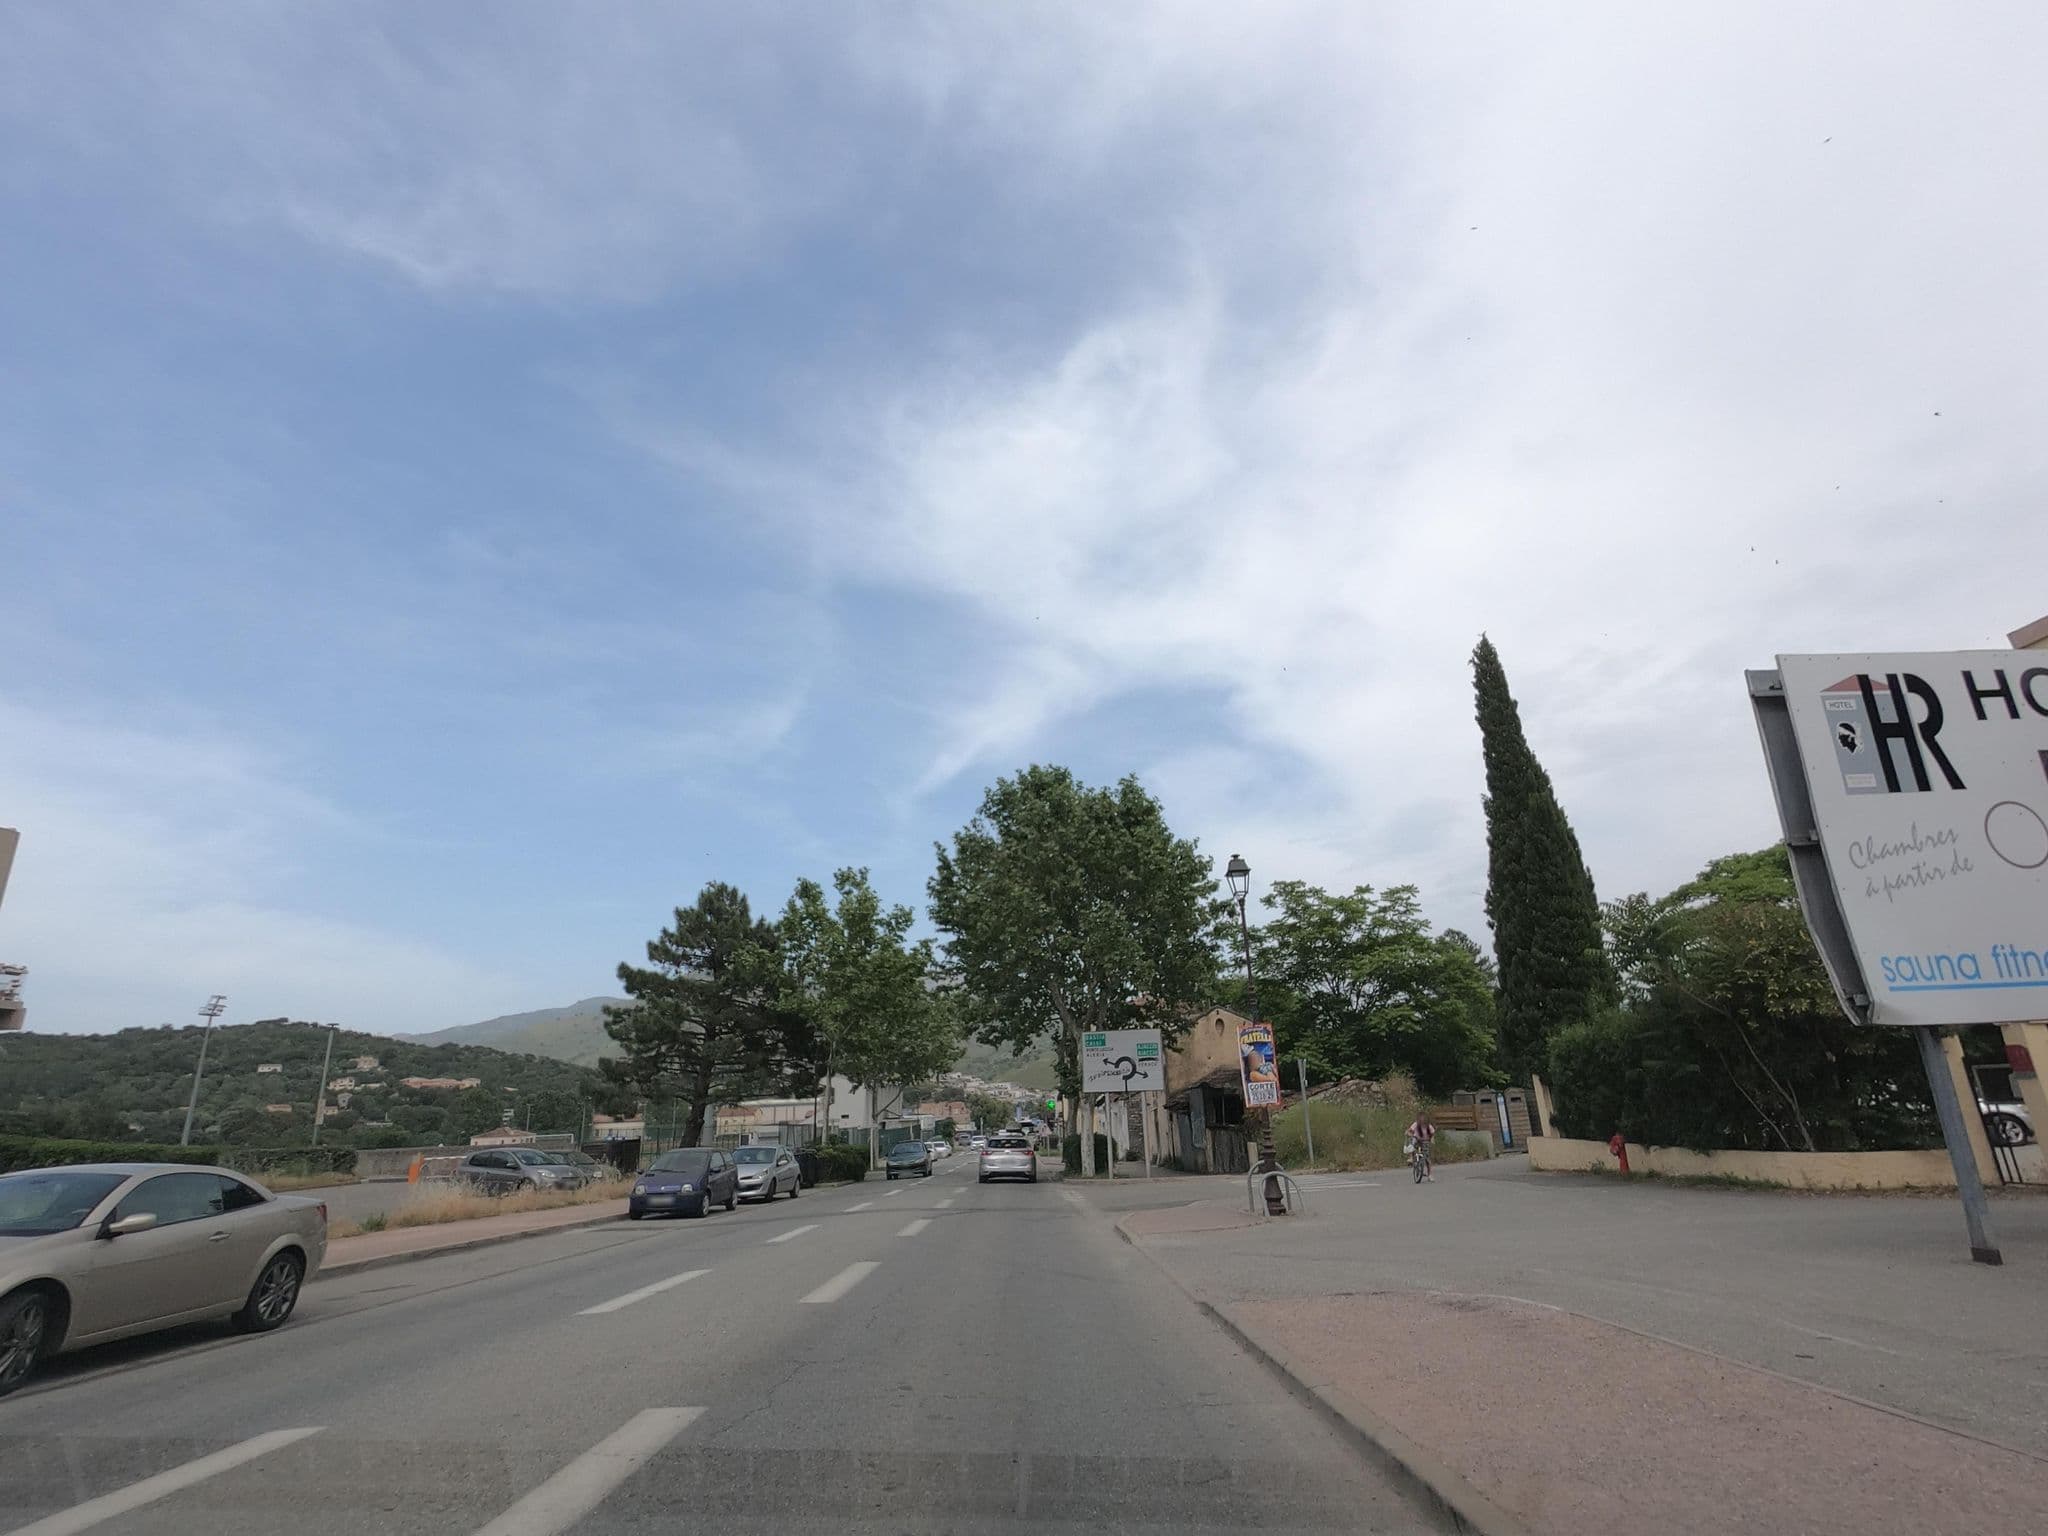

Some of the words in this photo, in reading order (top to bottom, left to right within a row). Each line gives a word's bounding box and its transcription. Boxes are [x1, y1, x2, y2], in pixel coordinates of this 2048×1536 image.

[1855, 672, 1967, 793] HR
[1849, 822, 1959, 870] Chambres
[1881, 864, 1947, 904] partir
[1949, 849, 1975, 876] de
[1881, 954, 1979, 984] sauna
[1991, 943, 2048, 979] fitn
[1249, 1083, 1275, 1091] CORTE
